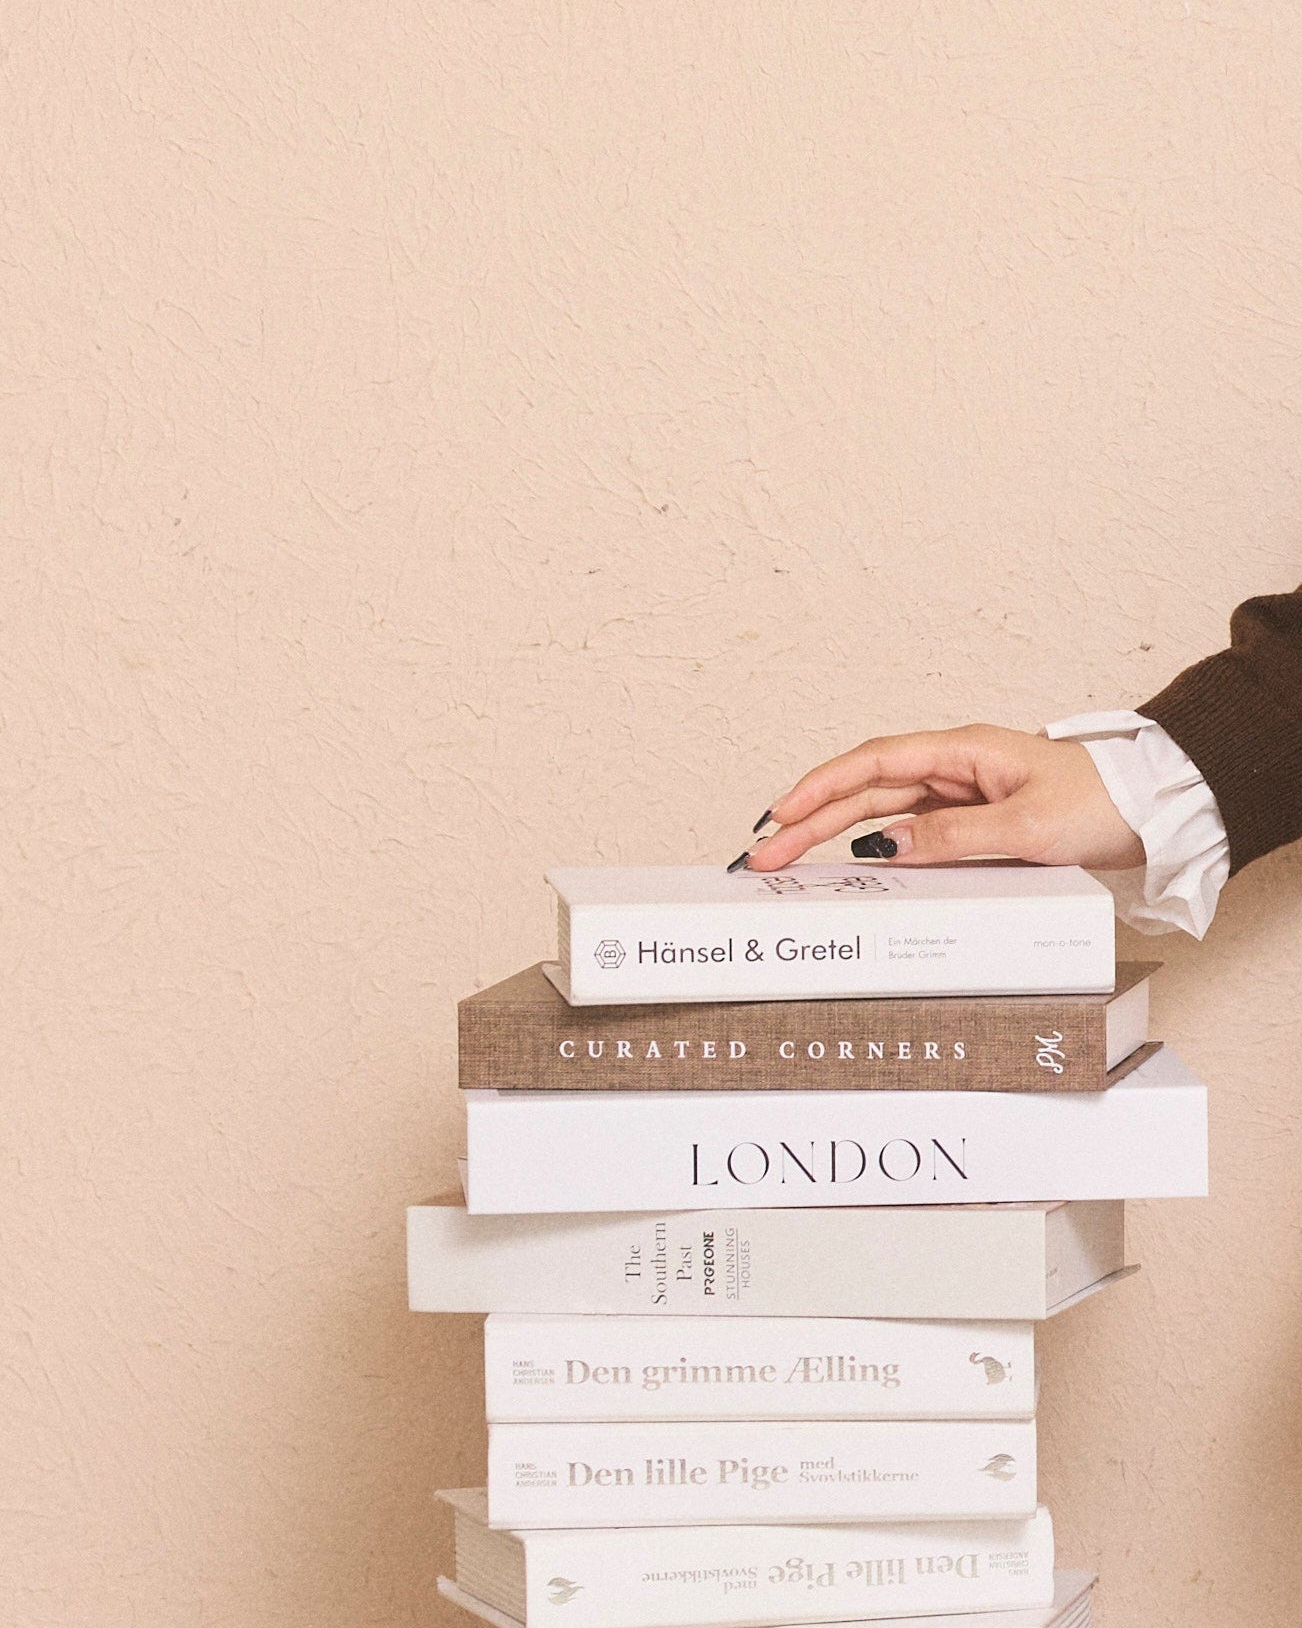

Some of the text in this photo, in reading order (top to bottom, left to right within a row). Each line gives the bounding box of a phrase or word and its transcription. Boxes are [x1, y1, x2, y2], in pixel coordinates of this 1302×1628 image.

[638, 935, 861, 964] Hänsel & Gretel
[559, 1040, 968, 1060] CURATED CORNERS
[692, 1138, 969, 1187] LONDON
[625, 1245, 641, 1282] The
[650, 1223, 668, 1305] Southern
[677, 1246, 692, 1280] Past
[725, 1228, 736, 1299] STUNNING
[741, 1240, 751, 1288] HOUSES
[565, 1355, 902, 1390] Den grimme Ælling
[567, 1459, 789, 1491] Den lille Pige
[800, 1457, 835, 1470] med
[723, 1579, 758, 1594] med
[768, 1554, 980, 1590] Den lille Pige
